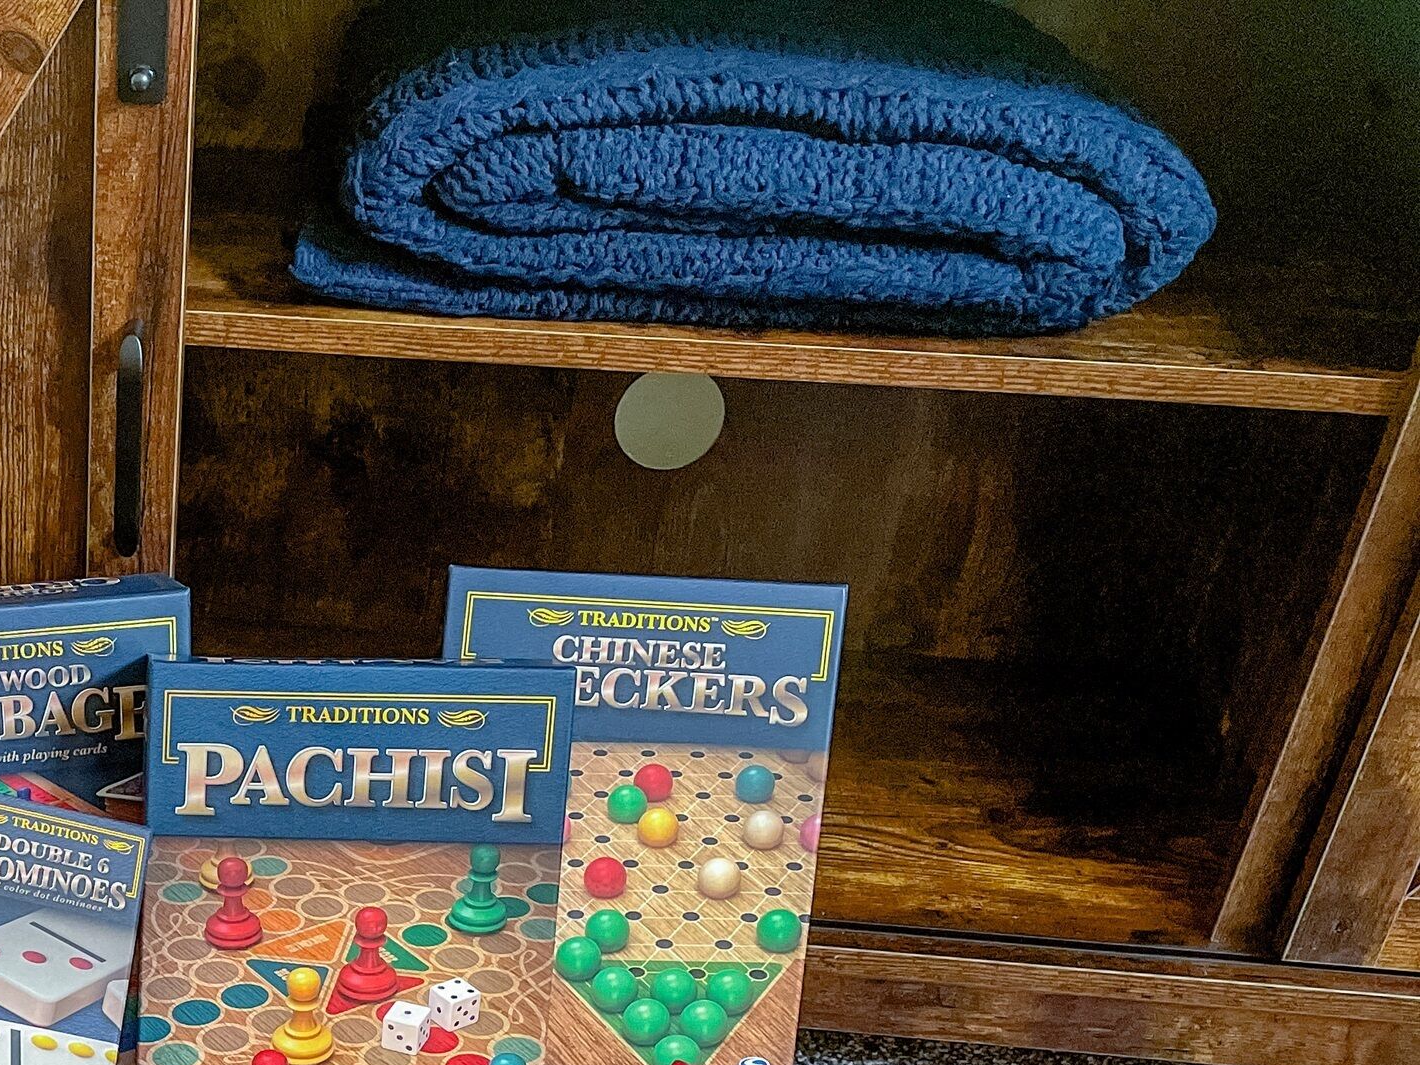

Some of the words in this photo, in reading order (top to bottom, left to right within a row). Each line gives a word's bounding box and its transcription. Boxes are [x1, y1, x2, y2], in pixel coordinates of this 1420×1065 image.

[578, 609, 712, 633] TRADITIONS
[552, 635, 727, 671] CHINESE
[574, 665, 809, 727] ECKERS
[286, 705, 430, 726] TRADITIONS
[22, 747, 70, 765] playing
[73, 743, 108, 757] cards
[175, 743, 539, 823] PACHISI
[11, 816, 99, 845] TRADITIONS
[97, 857, 110, 874] 6
[4, 882, 31, 895] color
[33, 889, 51, 900] dot
[52, 894, 103, 912] dominoes
